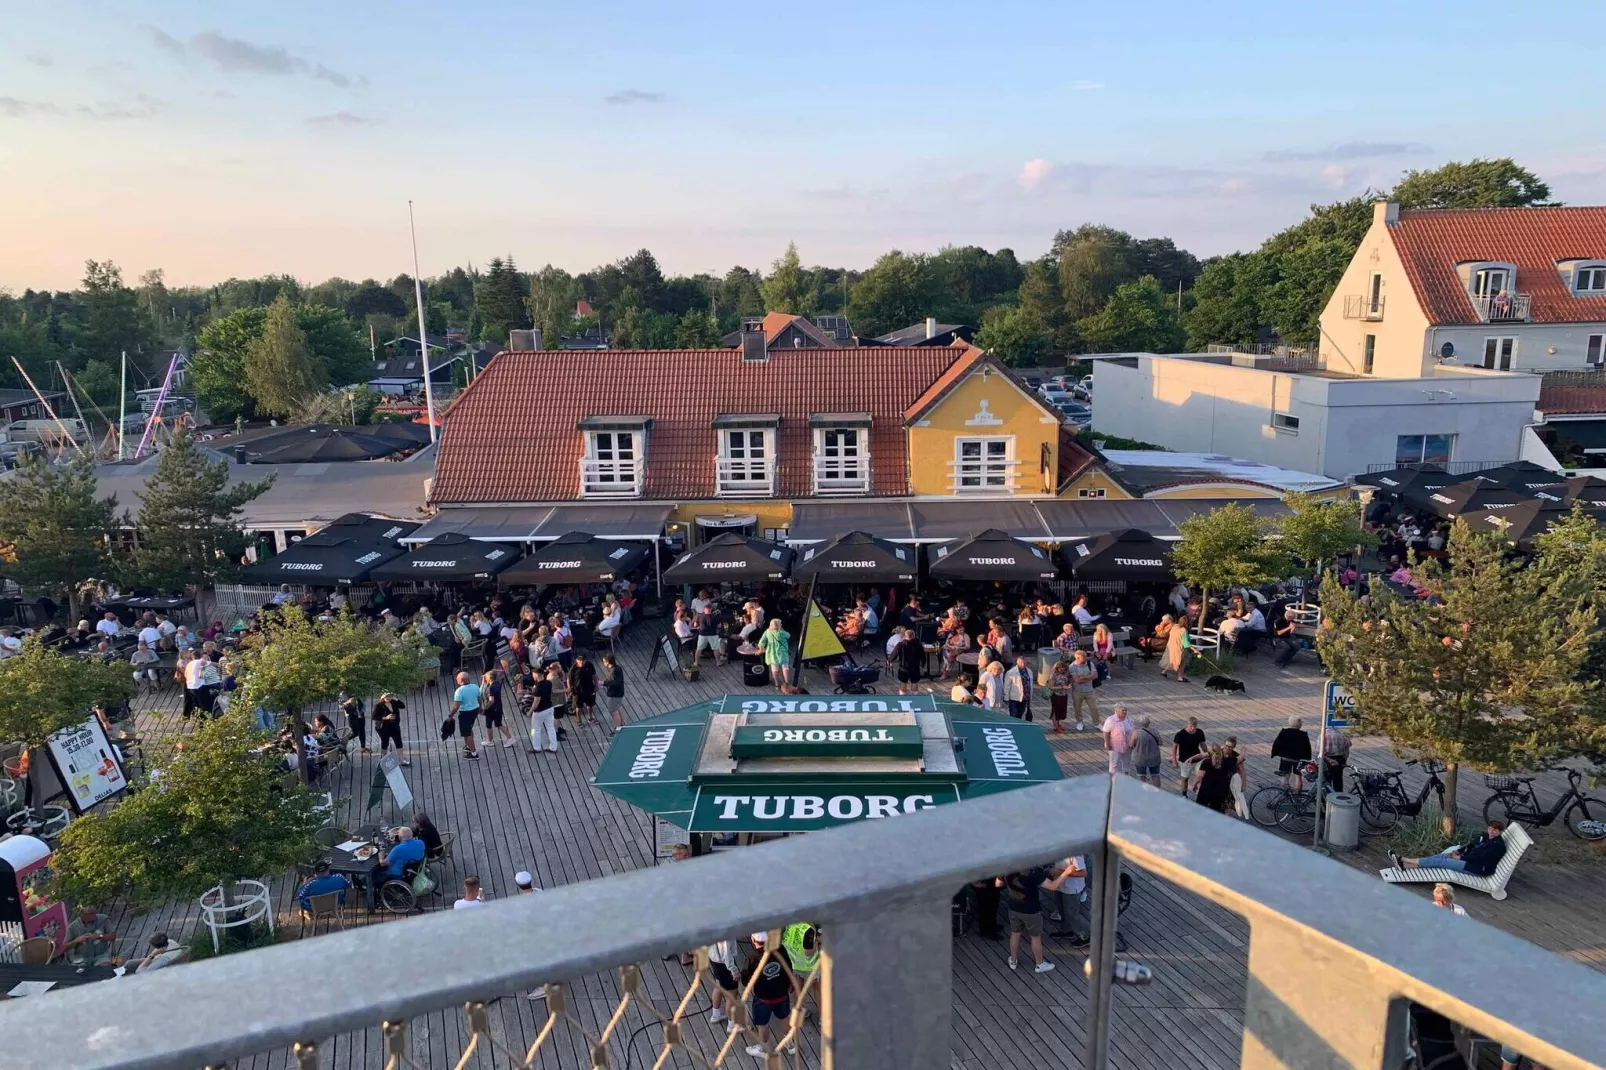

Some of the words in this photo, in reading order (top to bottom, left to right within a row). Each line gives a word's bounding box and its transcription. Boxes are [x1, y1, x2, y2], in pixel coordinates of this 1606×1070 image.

[538, 561, 581, 569] TUBORG
[969, 557, 1016, 565] TUBORG
[1114, 557, 1163, 566] TUBORG
[741, 700, 922, 712] TUBORG
[1334, 695, 1356, 706] WC
[60, 736, 78, 750] HAPPY
[77, 729, 93, 741] HOUR
[763, 729, 893, 742] TUBORG
[628, 728, 676, 778] TUBORG
[982, 728, 1029, 777] TUBORG
[713, 795, 937, 819] TUBORG
